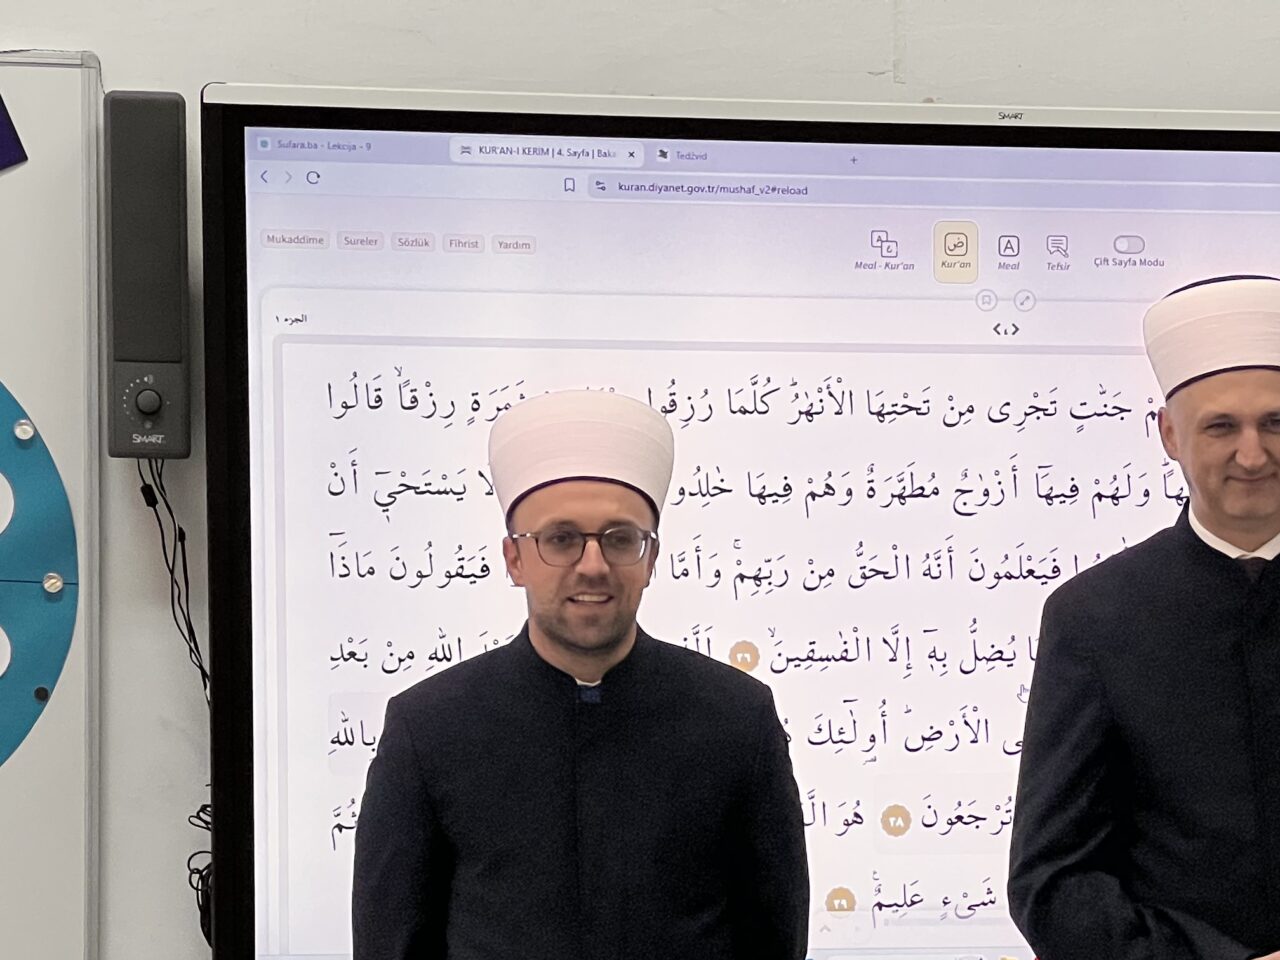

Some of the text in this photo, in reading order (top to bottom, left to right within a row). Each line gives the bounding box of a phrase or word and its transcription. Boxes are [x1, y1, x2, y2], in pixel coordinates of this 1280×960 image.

[997, 111, 1025, 121] SMART
[327, 140, 356, 153] Lekcija
[567, 148, 592, 163] Sayfa
[265, 234, 326, 247] Mukaddime
[343, 236, 380, 248] Sureler
[854, 259, 879, 272] Meal
[997, 260, 1021, 272] Meal
[1047, 261, 1071, 273] Tefsir
[1113, 257, 1138, 270] Sayfa
[1140, 258, 1166, 269] Modu
[132, 433, 165, 444] SMART
